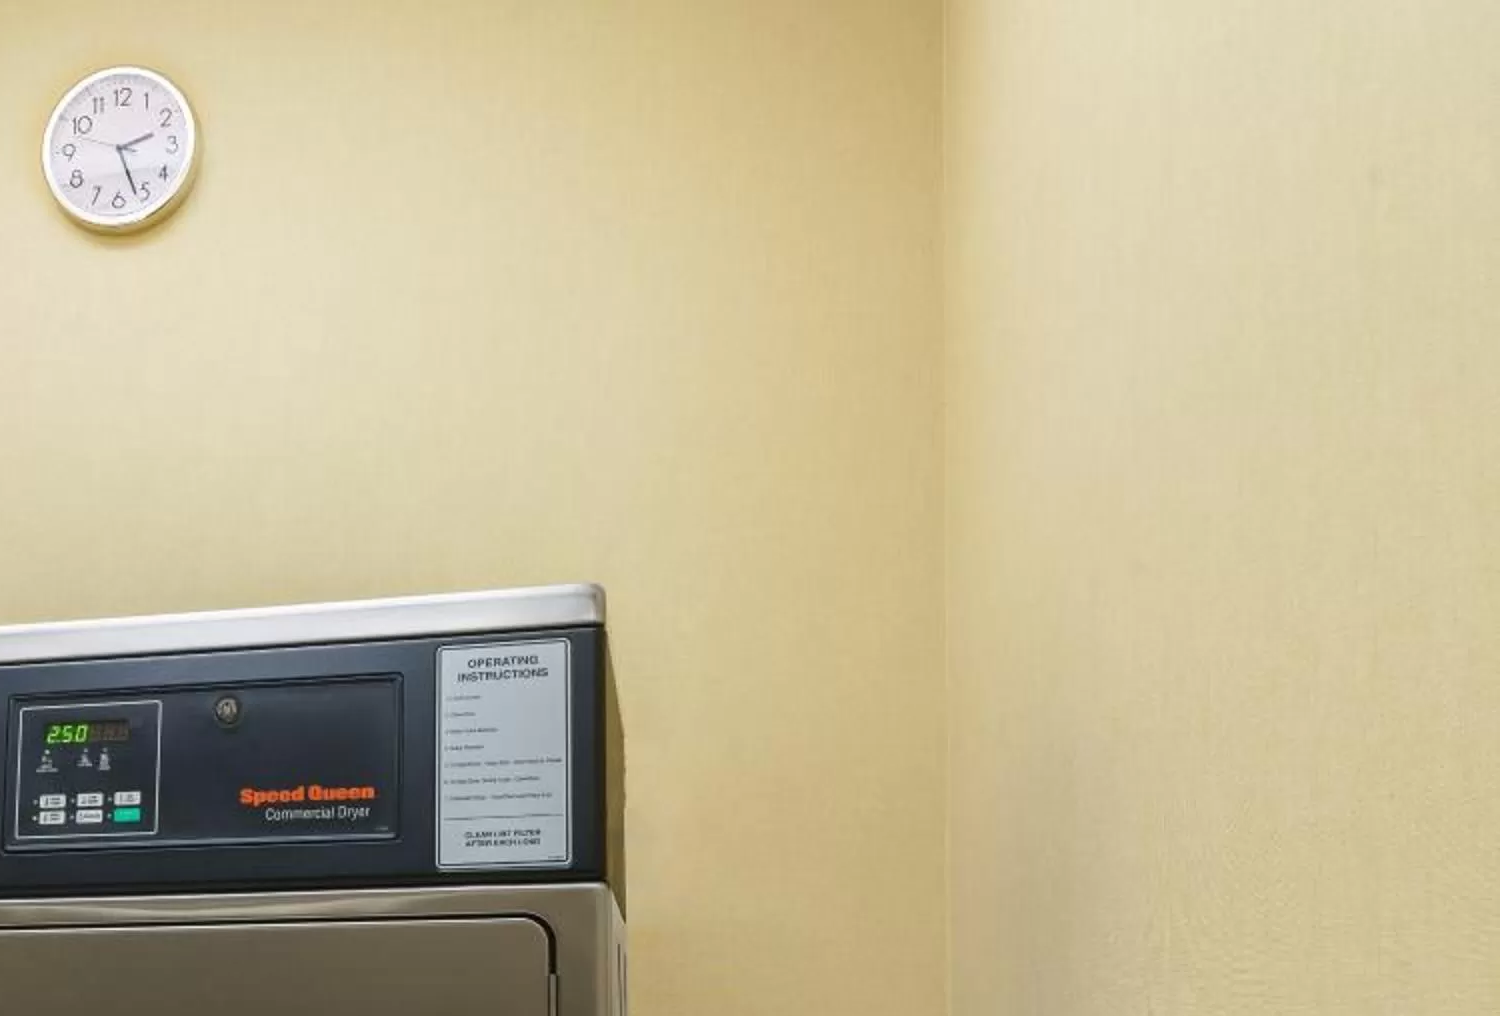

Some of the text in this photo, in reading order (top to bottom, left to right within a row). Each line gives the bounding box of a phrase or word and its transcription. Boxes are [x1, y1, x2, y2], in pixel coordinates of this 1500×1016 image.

[93, 96, 105, 115] 11
[113, 87, 133, 107] 12
[143, 92, 149, 111] 1
[72, 115, 93, 135] 10
[159, 107, 172, 128] 2
[61, 143, 76, 162] 9
[166, 135, 179, 154] 3
[69, 169, 84, 189] 8
[158, 164, 169, 182] 4
[91, 186, 102, 206] 7
[111, 190, 126, 209] 6
[139, 182, 151, 202] 5
[467, 655, 540, 669] OPERATING
[457, 667, 549, 682] INSTRUCTIONS
[239, 783, 376, 806] Speed Queen
[265, 805, 371, 822] Commercial Dryer
